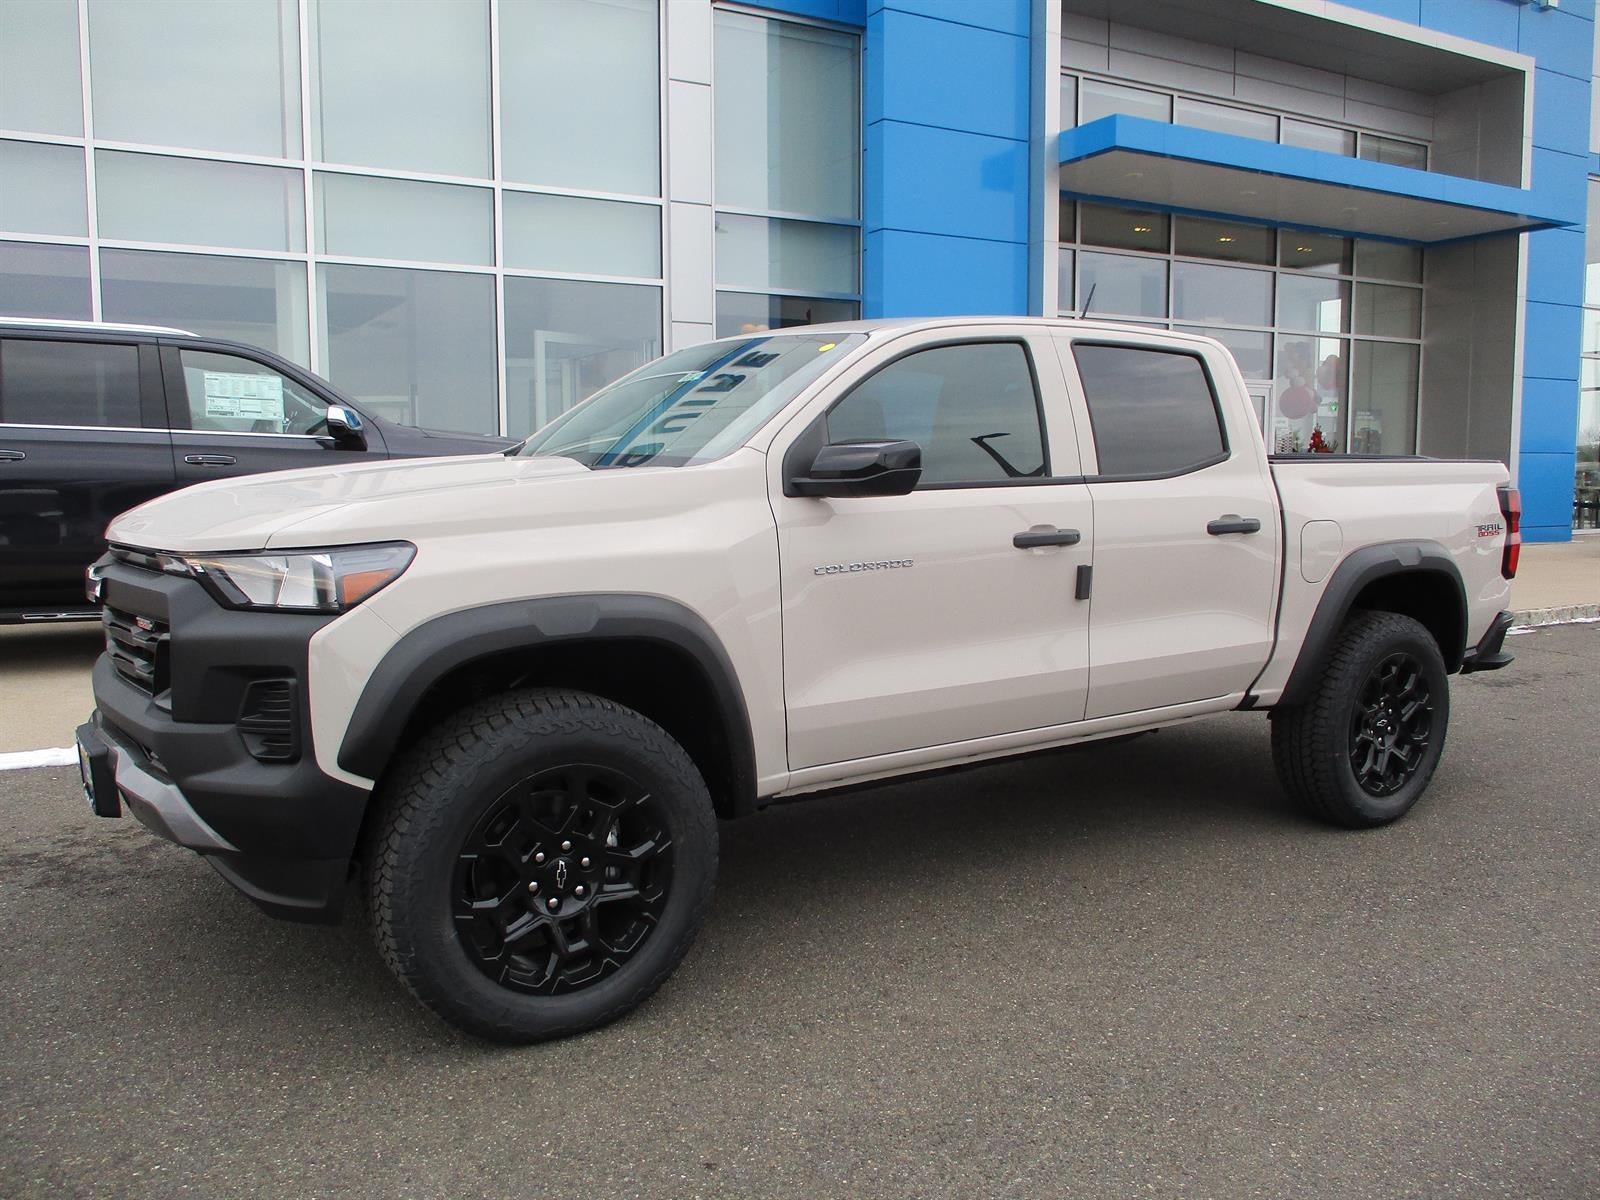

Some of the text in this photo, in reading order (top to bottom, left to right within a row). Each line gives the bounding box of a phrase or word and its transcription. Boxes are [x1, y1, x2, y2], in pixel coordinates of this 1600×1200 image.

[1475, 523, 1504, 531] TRAIL
[1478, 529, 1500, 538] BOSS
[814, 559, 914, 576] COLORADO
